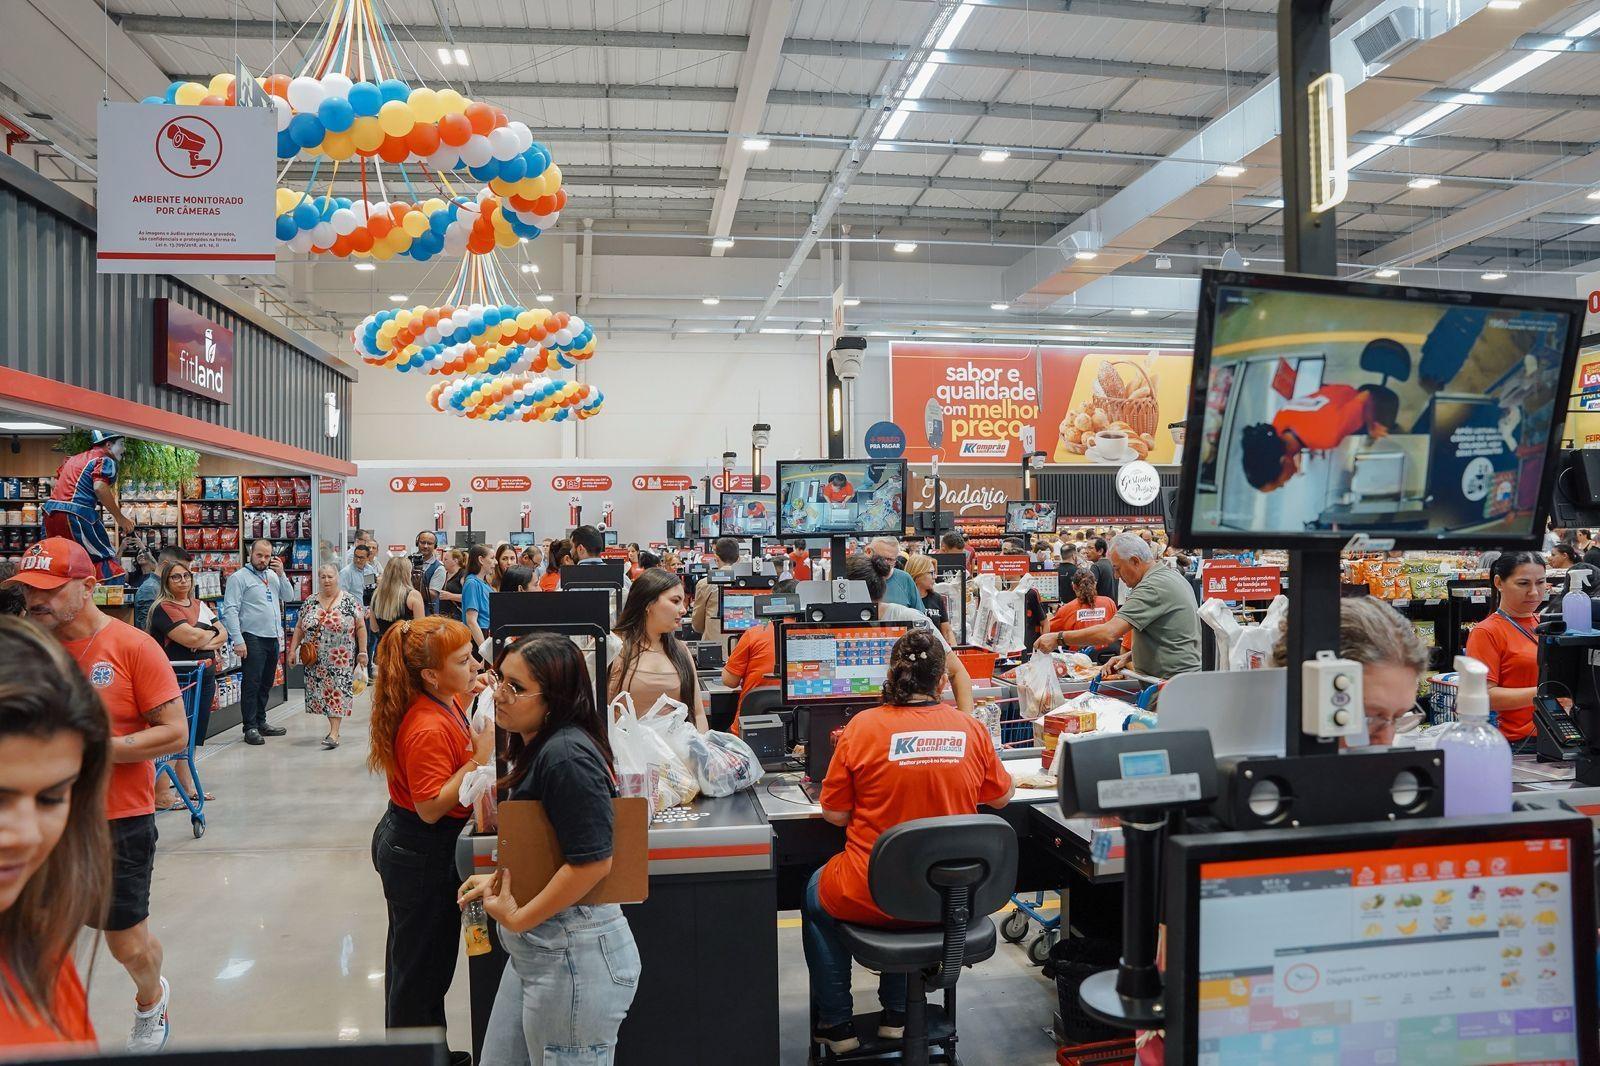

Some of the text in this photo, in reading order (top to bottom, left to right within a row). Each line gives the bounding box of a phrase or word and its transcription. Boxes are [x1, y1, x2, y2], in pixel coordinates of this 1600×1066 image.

[132, 195, 244, 205] AMBIENTE MONITORADO
[156, 205, 221, 216] POR CÂMERAS
[179, 349, 223, 394] fitland
[946, 361, 1020, 382] sabor e
[936, 380, 1036, 404] qualidade
[951, 419, 1024, 442] preço
[1026, 435, 1033, 445] 13
